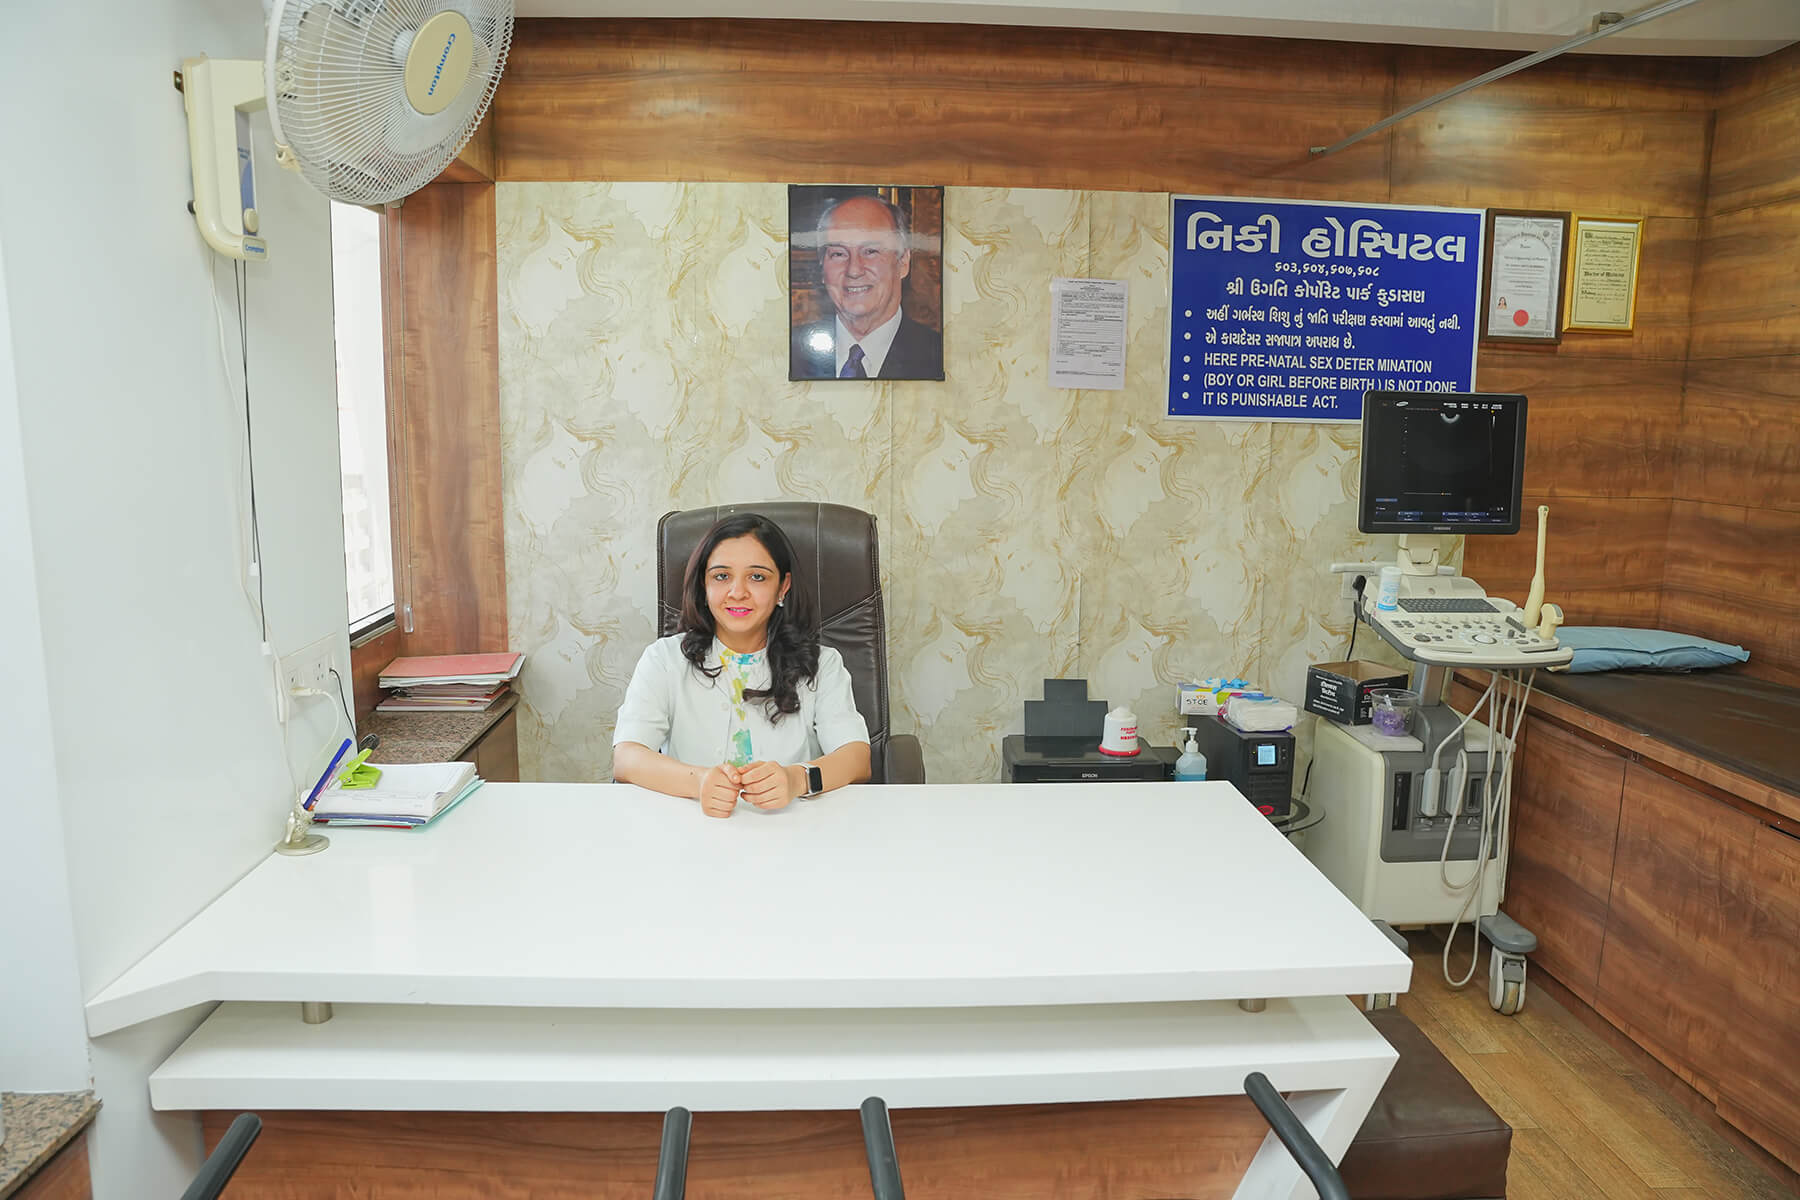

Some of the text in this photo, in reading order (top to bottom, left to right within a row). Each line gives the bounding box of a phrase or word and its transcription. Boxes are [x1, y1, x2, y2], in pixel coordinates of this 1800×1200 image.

[428, 33, 456, 96] Crompton
[1186, 211, 1281, 254] નિકી
[1301, 216, 1467, 263] હોસ્પિટલ
[1226, 277, 1244, 296] શ્રી
[1250, 278, 1289, 297] ઉગતિ
[1346, 282, 1374, 301] પાર્ક
[1376, 287, 1426, 308] કુડાસણ
[1206, 304, 1461, 334] અહીં ગર્ભસ્થ શિશુ નું જાતિ પરીક્ષણ કરવામાં આવતું નથી.
[1205, 327, 1356, 350] એ કાયદેસર સજાપાત્ર અપરાધ છે.
[1204, 352, 1433, 374] HERE PRE-NATAL SEX DETER MINATION
[1204, 372, 1234, 389] (BOY
[1236, 374, 1255, 388] OR
[1257, 375, 1286, 388] GIRL
[1288, 375, 1337, 390] BEFORE
[1384, 379, 1396, 391] IS
[1398, 380, 1423, 392] NOT
[1424, 381, 1457, 393] DONE
[1203, 391, 1339, 409] IT IS PUNISHABLE ACT.
